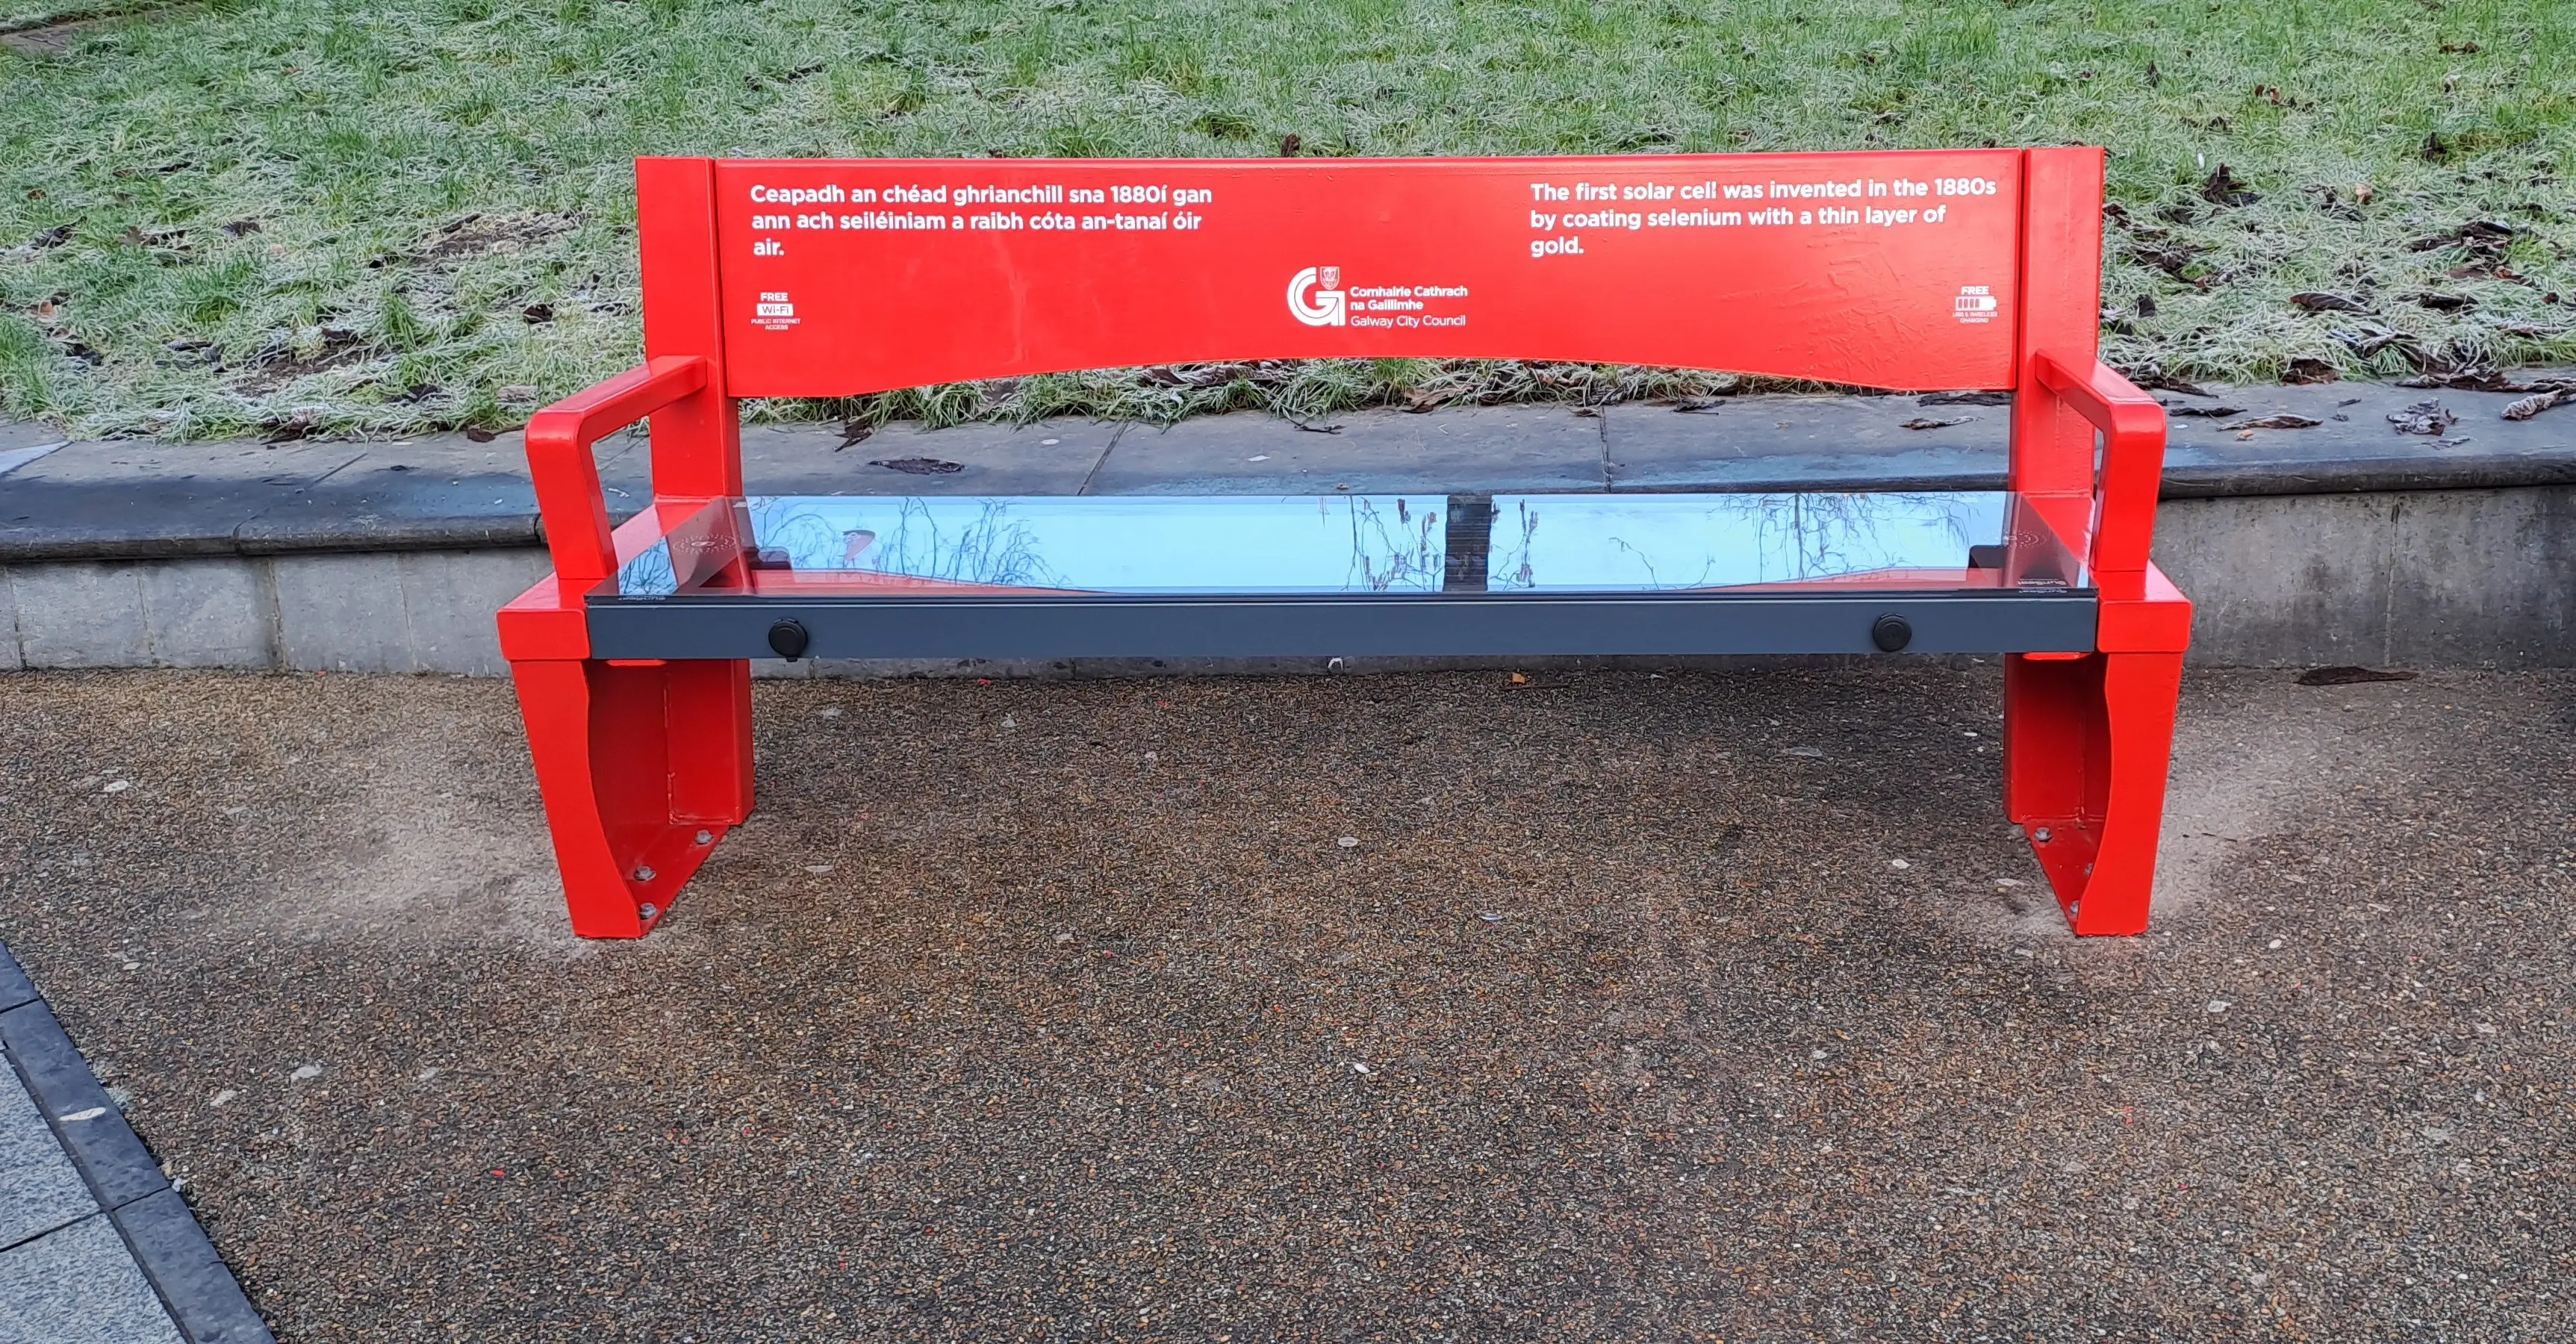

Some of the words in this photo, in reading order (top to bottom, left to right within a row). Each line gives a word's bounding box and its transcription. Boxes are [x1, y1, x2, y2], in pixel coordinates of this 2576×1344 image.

[750, 184, 844, 206] Ceapadh
[850, 189, 877, 203] an
[883, 184, 947, 203] chéad
[953, 184, 1063, 206] ghrianchill
[1069, 189, 1104, 203] sna
[1110, 184, 1168, 203] 1880í
[1173, 189, 1212, 208] gan
[1531, 183, 1569, 200] The
[1575, 183, 1617, 200] first
[1623, 182, 1674, 199] solar
[1681, 181, 1716, 199] cell
[1723, 185, 1763, 199] was
[1770, 179, 1861, 198] invented
[1869, 179, 1886, 196] in
[1894, 178, 1928, 196] the
[1935, 178, 1996, 195] 1880s
[752, 215, 790, 229] ann
[797, 211, 833, 229] ach
[840, 211, 946, 229] seiléiniam
[952, 216, 964, 229] a
[971, 211, 1024, 230] raibh
[1030, 211, 1075, 230] cóta
[1081, 211, 1168, 230] an-tanaí
[1173, 211, 1201, 230] óir
[1531, 210, 1556, 231] by
[1563, 209, 1640, 229] coating
[1648, 208, 1741, 226] selenium
[1748, 208, 1793, 225] with
[1800, 211, 1811, 225] a
[1818, 206, 1858, 224] thin
[1866, 206, 1917, 226] layer
[1923, 205, 1946, 223] of
[753, 237, 785, 256] air.
[1531, 236, 1584, 258] gold.
[760, 292, 788, 302] FREE
[1350, 286, 1411, 297] Comhairle
[1414, 285, 1468, 297] Cathrach
[1961, 286, 1989, 295] FREE
[1350, 301, 1365, 311] na
[1368, 299, 1424, 311] Gaillimhe
[1351, 315, 1393, 329] Galway
[1396, 315, 1419, 329] City
[1422, 314, 1466, 326] Council
